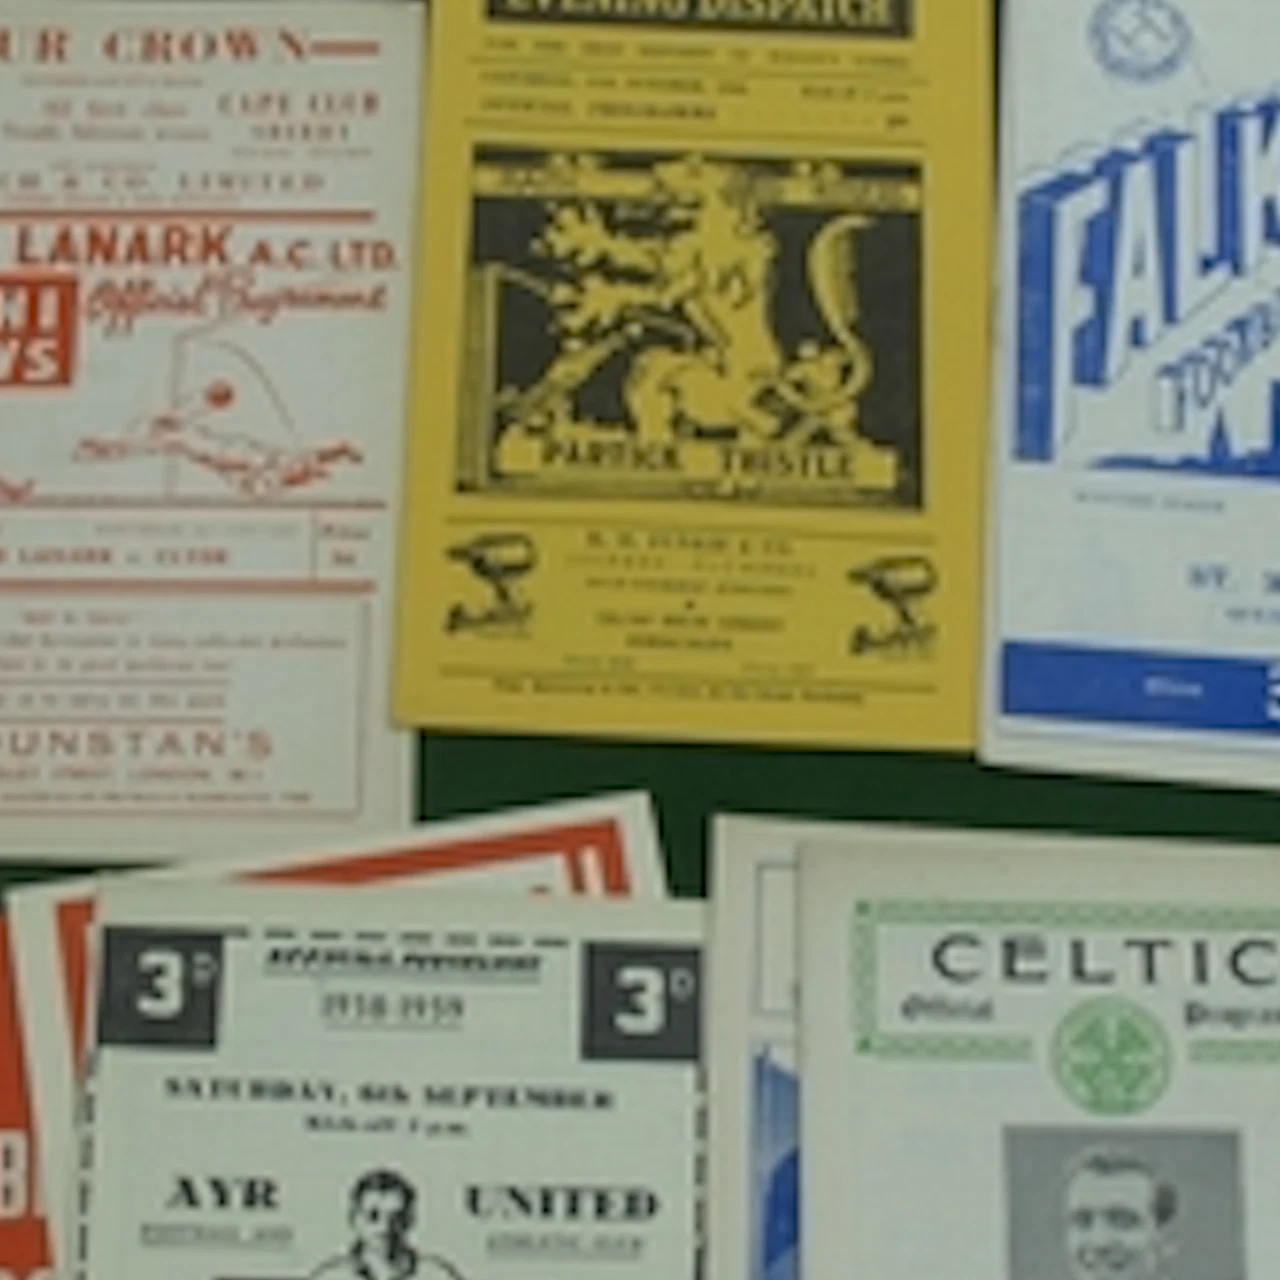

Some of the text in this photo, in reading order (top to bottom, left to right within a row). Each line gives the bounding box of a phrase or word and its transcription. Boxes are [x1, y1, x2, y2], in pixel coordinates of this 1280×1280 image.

[101, 27, 310, 64] CROWN
[16, 223, 235, 266] LANARK
[541, 439, 855, 479] PARTICK THISTLE
[931, 932, 1279, 988] CELTIC
[163, 1076, 350, 1108] SATURDAY,
[424, 1082, 616, 1111] SEPTEMBER
[164, 1175, 661, 1222] AYR UNITED
